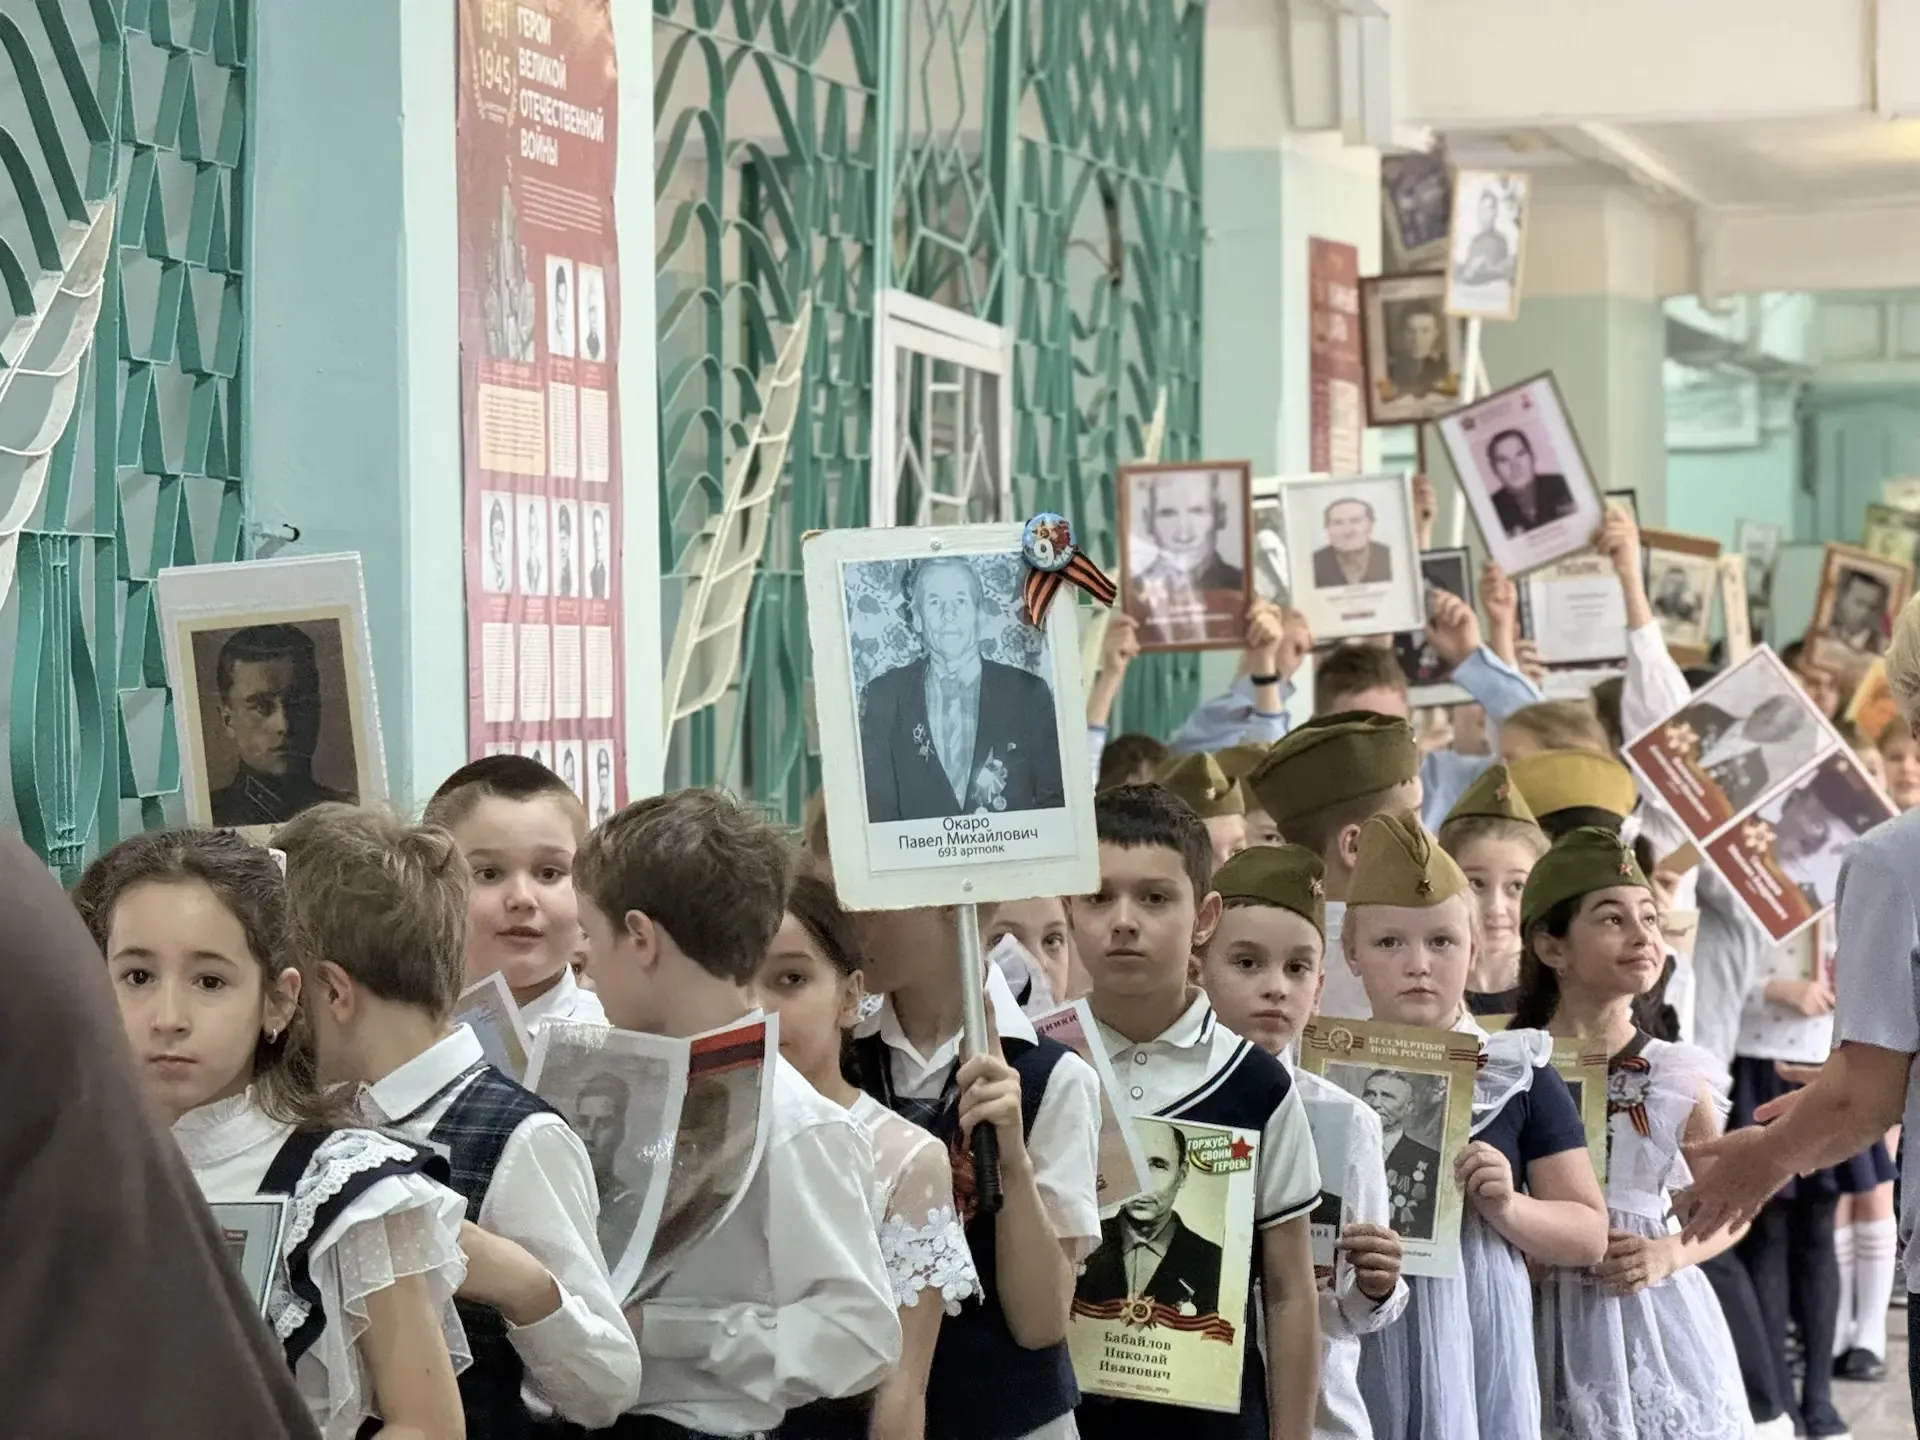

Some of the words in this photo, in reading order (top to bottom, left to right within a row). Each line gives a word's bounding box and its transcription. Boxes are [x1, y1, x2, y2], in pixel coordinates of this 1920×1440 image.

[481, 0, 508, 40] 1941
[517, 5, 551, 46] ГЕРОИ
[478, 47, 512, 96] 1945
[518, 47, 567, 91] ВЕЛИКОЙ
[519, 88, 604, 143] ОТЕЧЕСТВЕННОЙ
[520, 124, 559, 168] ВОЙНЫ
[1034, 539, 1054, 568] 9
[942, 816, 990, 832] Окаро
[898, 834, 943, 849] Павел
[946, 828, 1038, 846] Михайлович
[938, 846, 957, 858] 693
[960, 844, 1005, 858] артполк
[1370, 1046, 1399, 1057] ПОЛК
[1400, 1048, 1443, 1061] РОССИИ
[1187, 1136, 1230, 1151] ГОРЖУСЬ
[1200, 1148, 1232, 1162] СВОИМ
[1104, 1331, 1171, 1351] Бабайлов
[1104, 1346, 1168, 1365] Николай
[1099, 1360, 1171, 1380] Иванович
